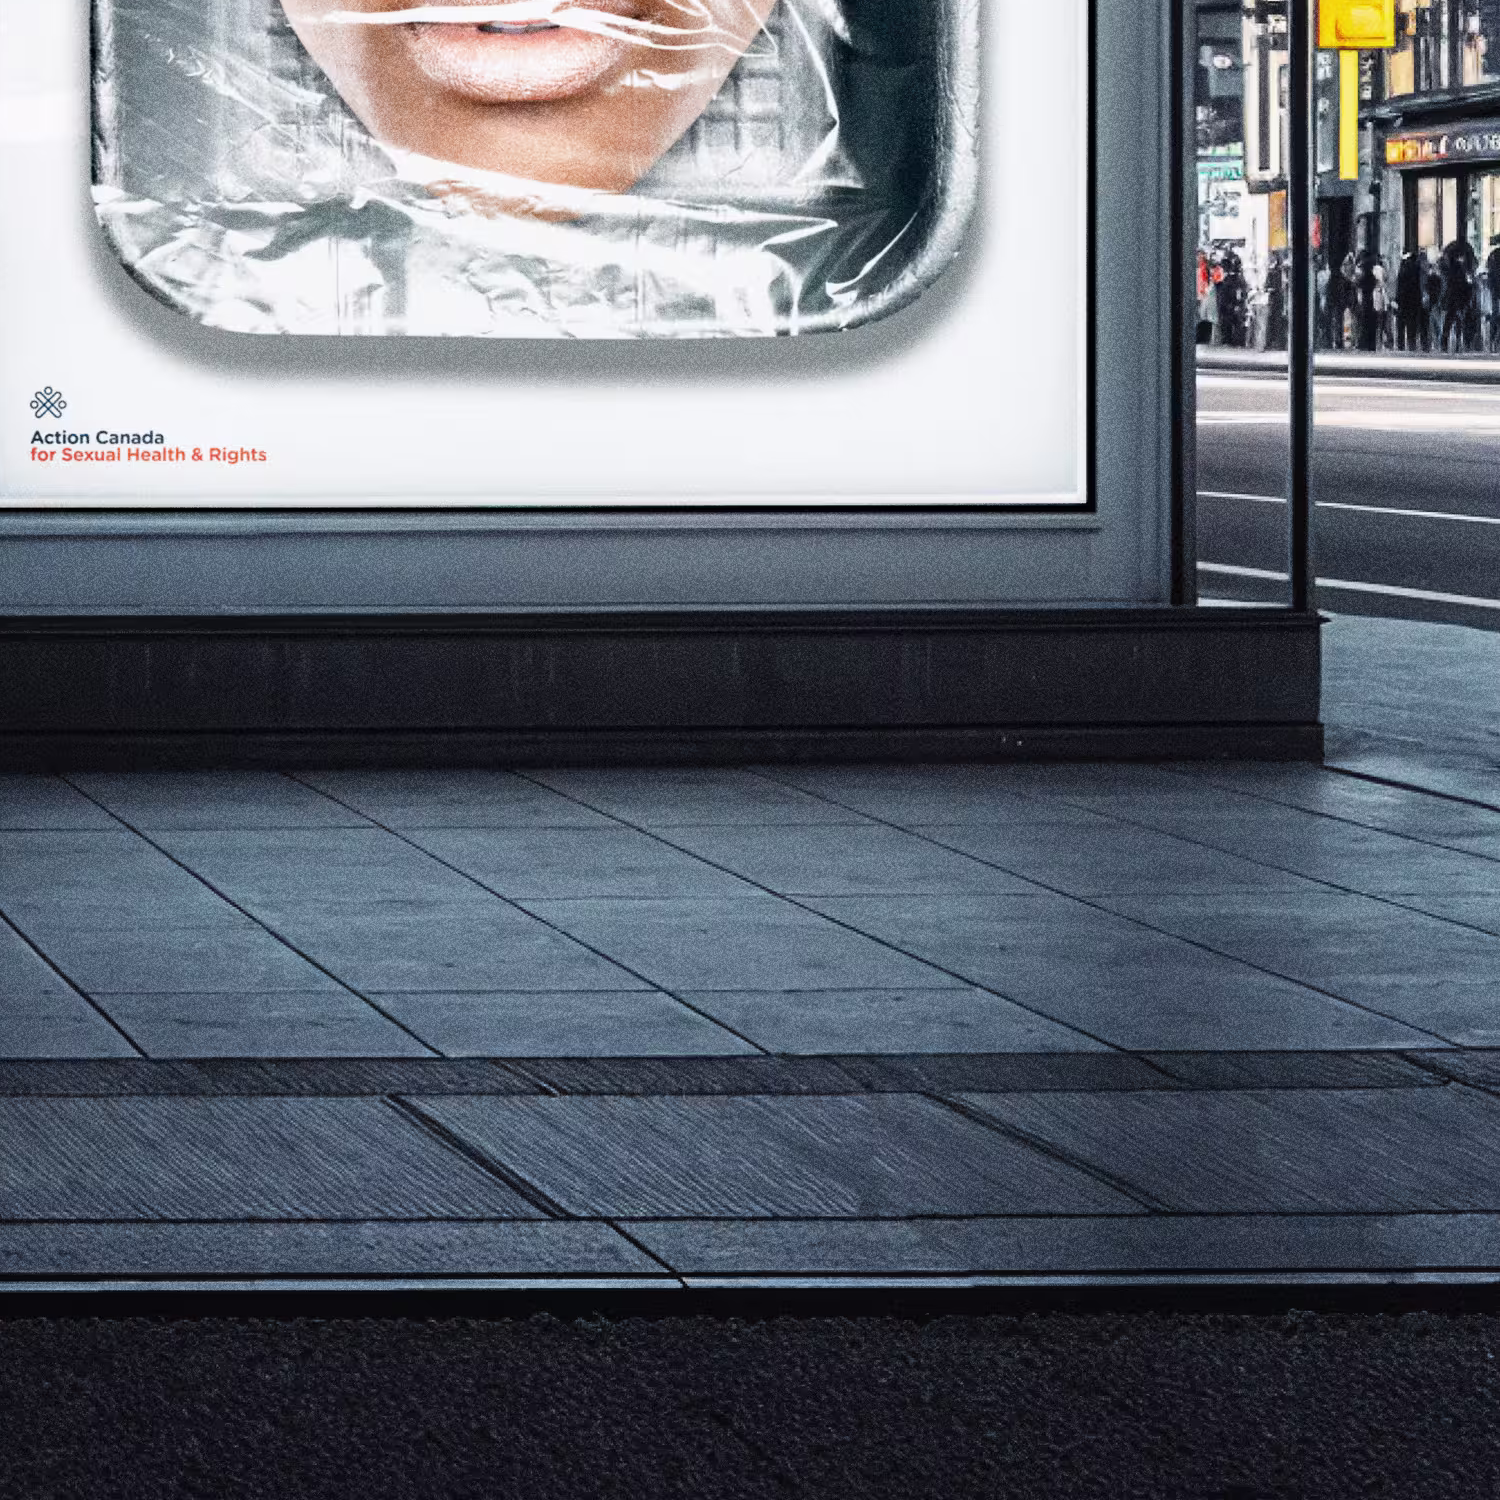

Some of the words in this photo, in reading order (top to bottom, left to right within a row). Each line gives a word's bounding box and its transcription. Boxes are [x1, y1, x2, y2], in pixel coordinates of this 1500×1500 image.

[31, 430, 90, 445] Action
[96, 430, 164, 445] Canada
[31, 447, 57, 462] for
[62, 447, 121, 462] Sexual
[127, 447, 186, 462] Health
[191, 447, 203, 462] &
[209, 447, 267, 464] Rights
